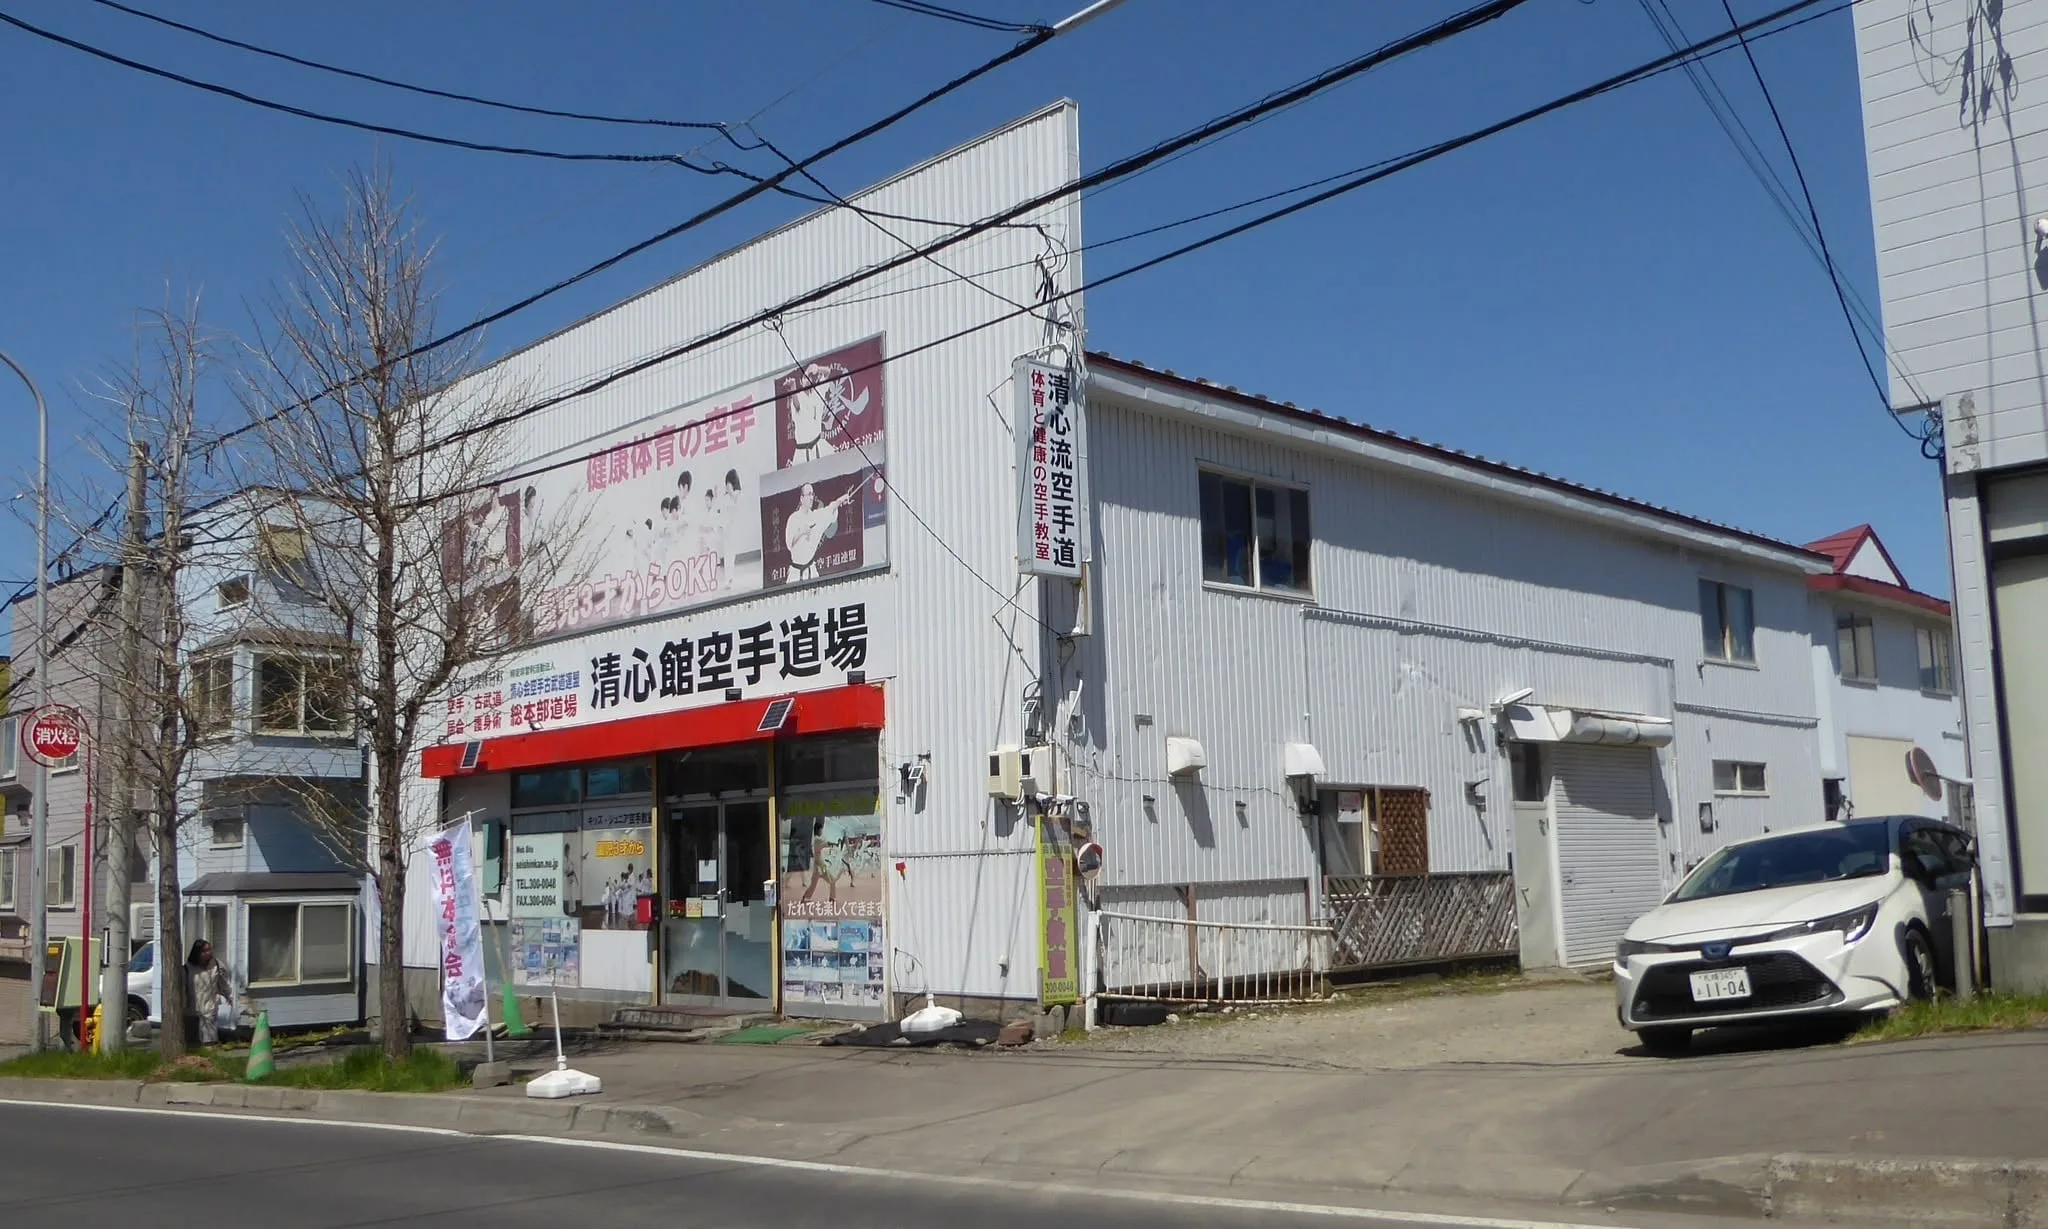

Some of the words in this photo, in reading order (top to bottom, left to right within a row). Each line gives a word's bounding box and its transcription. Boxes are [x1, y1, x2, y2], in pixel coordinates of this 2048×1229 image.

[586, 395, 756, 493] 健康体育の空手
[1031, 369, 1050, 561] 体育と健康の空手教室
[1048, 372, 1076, 568] 清心流空手道
[590, 602, 868, 709] 清心館空手道場
[36, 727, 76, 745] 消火栓
[510, 694, 577, 727] 総本部道場
[787, 901, 883, 916] だれでも楽しくできます
[1706, 980, 1746, 997] 11-04
